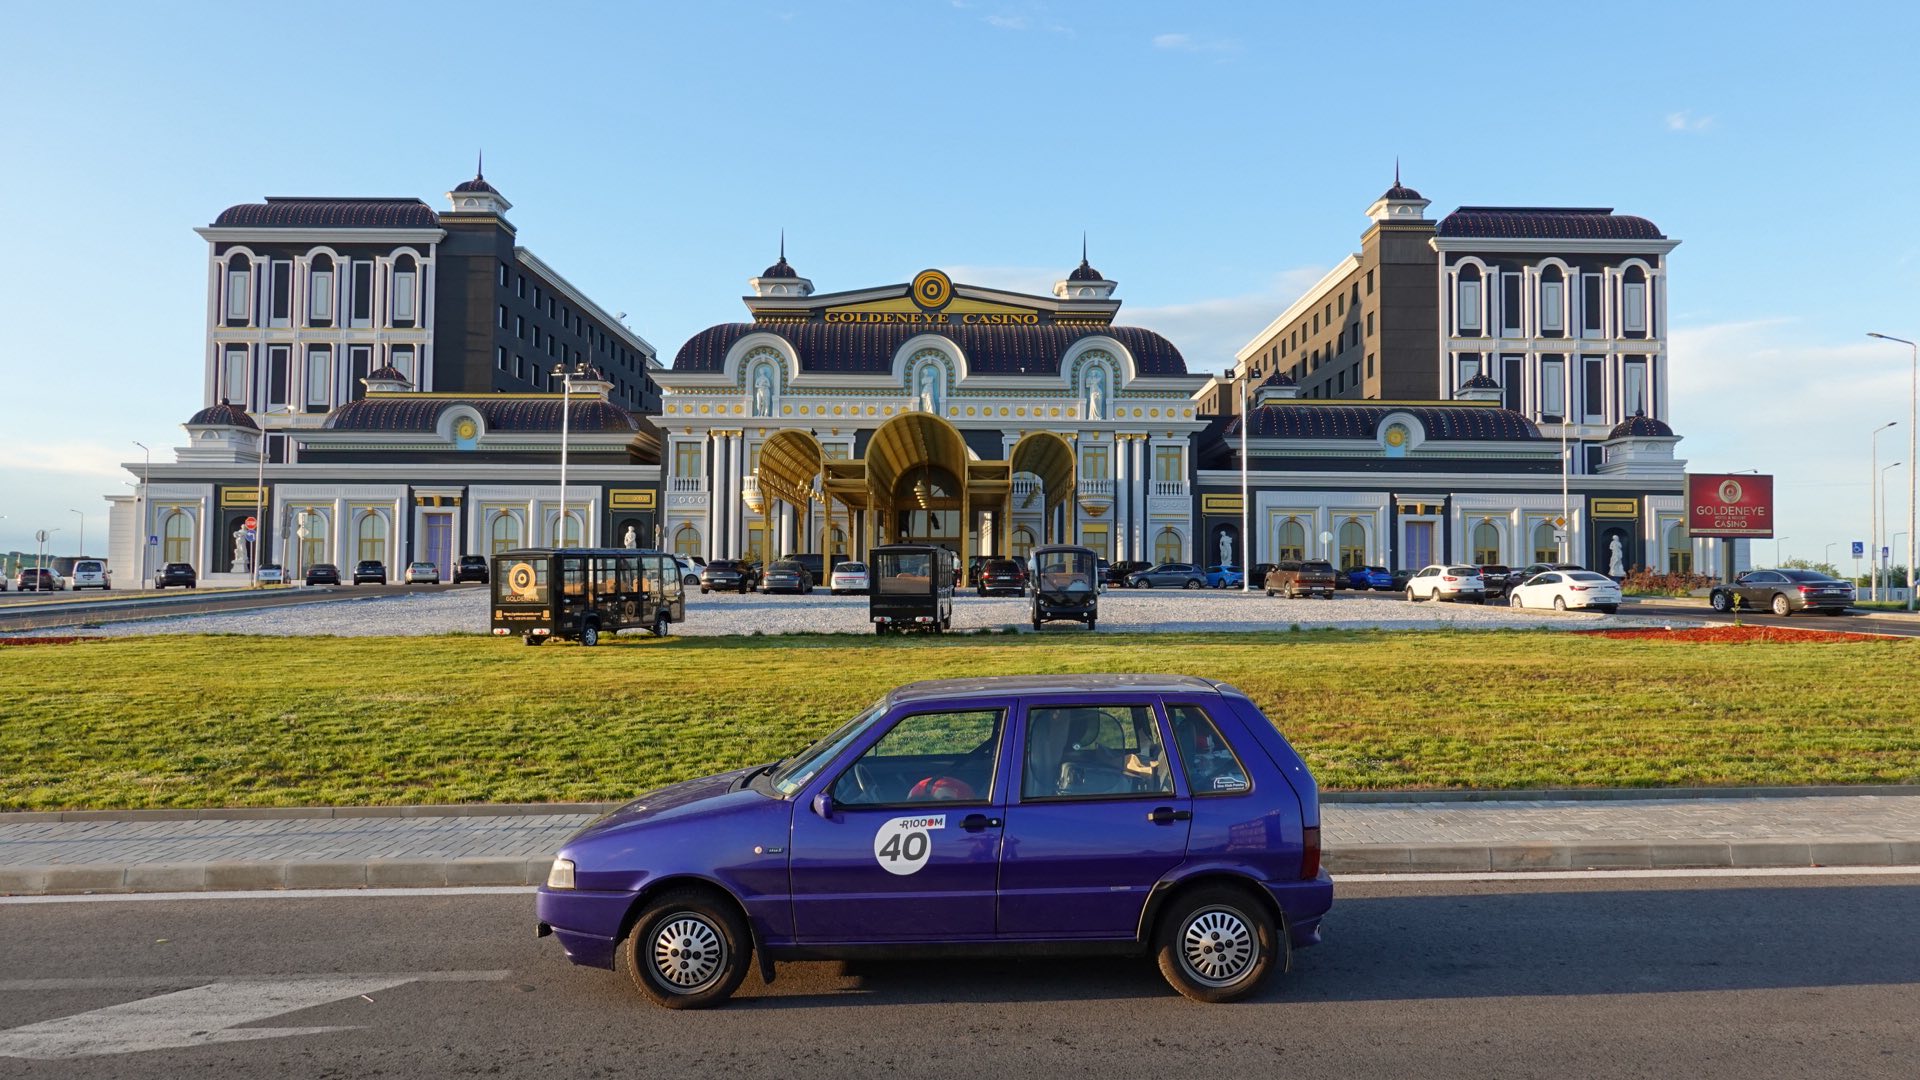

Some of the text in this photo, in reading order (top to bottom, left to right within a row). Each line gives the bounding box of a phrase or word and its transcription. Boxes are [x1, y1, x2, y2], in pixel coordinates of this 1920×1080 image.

[824, 312, 1039, 325] GOLDENEYE CASINO
[1696, 505, 1765, 516] GOLDENEYE
[1714, 520, 1748, 528] CASINO
[879, 831, 928, 862] 40
